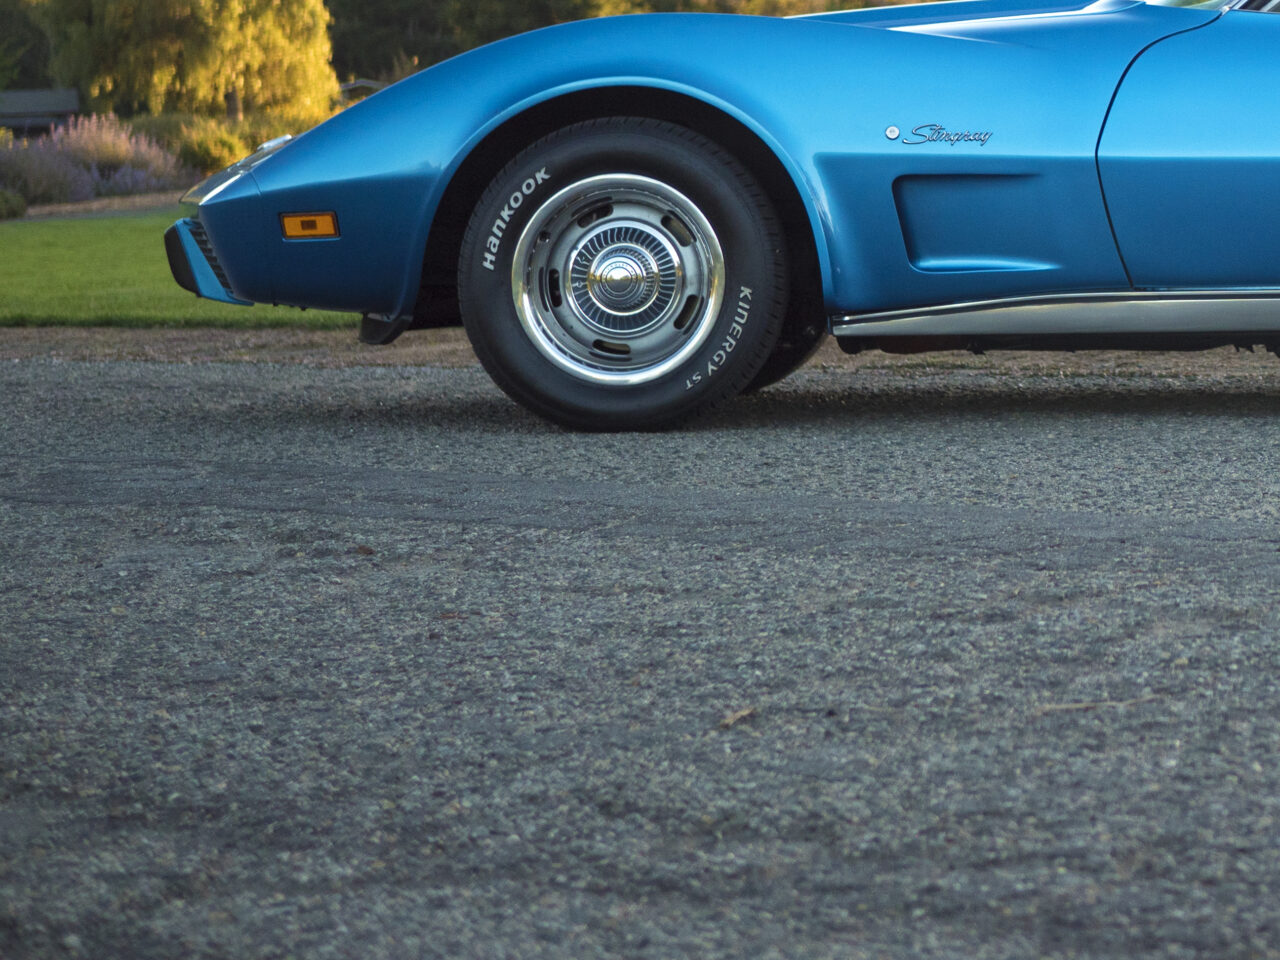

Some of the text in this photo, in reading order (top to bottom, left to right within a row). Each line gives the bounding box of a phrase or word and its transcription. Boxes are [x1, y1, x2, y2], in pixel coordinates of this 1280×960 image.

[902, 124, 993, 146] Stingray
[685, 285, 753, 390] KINERGY ST
